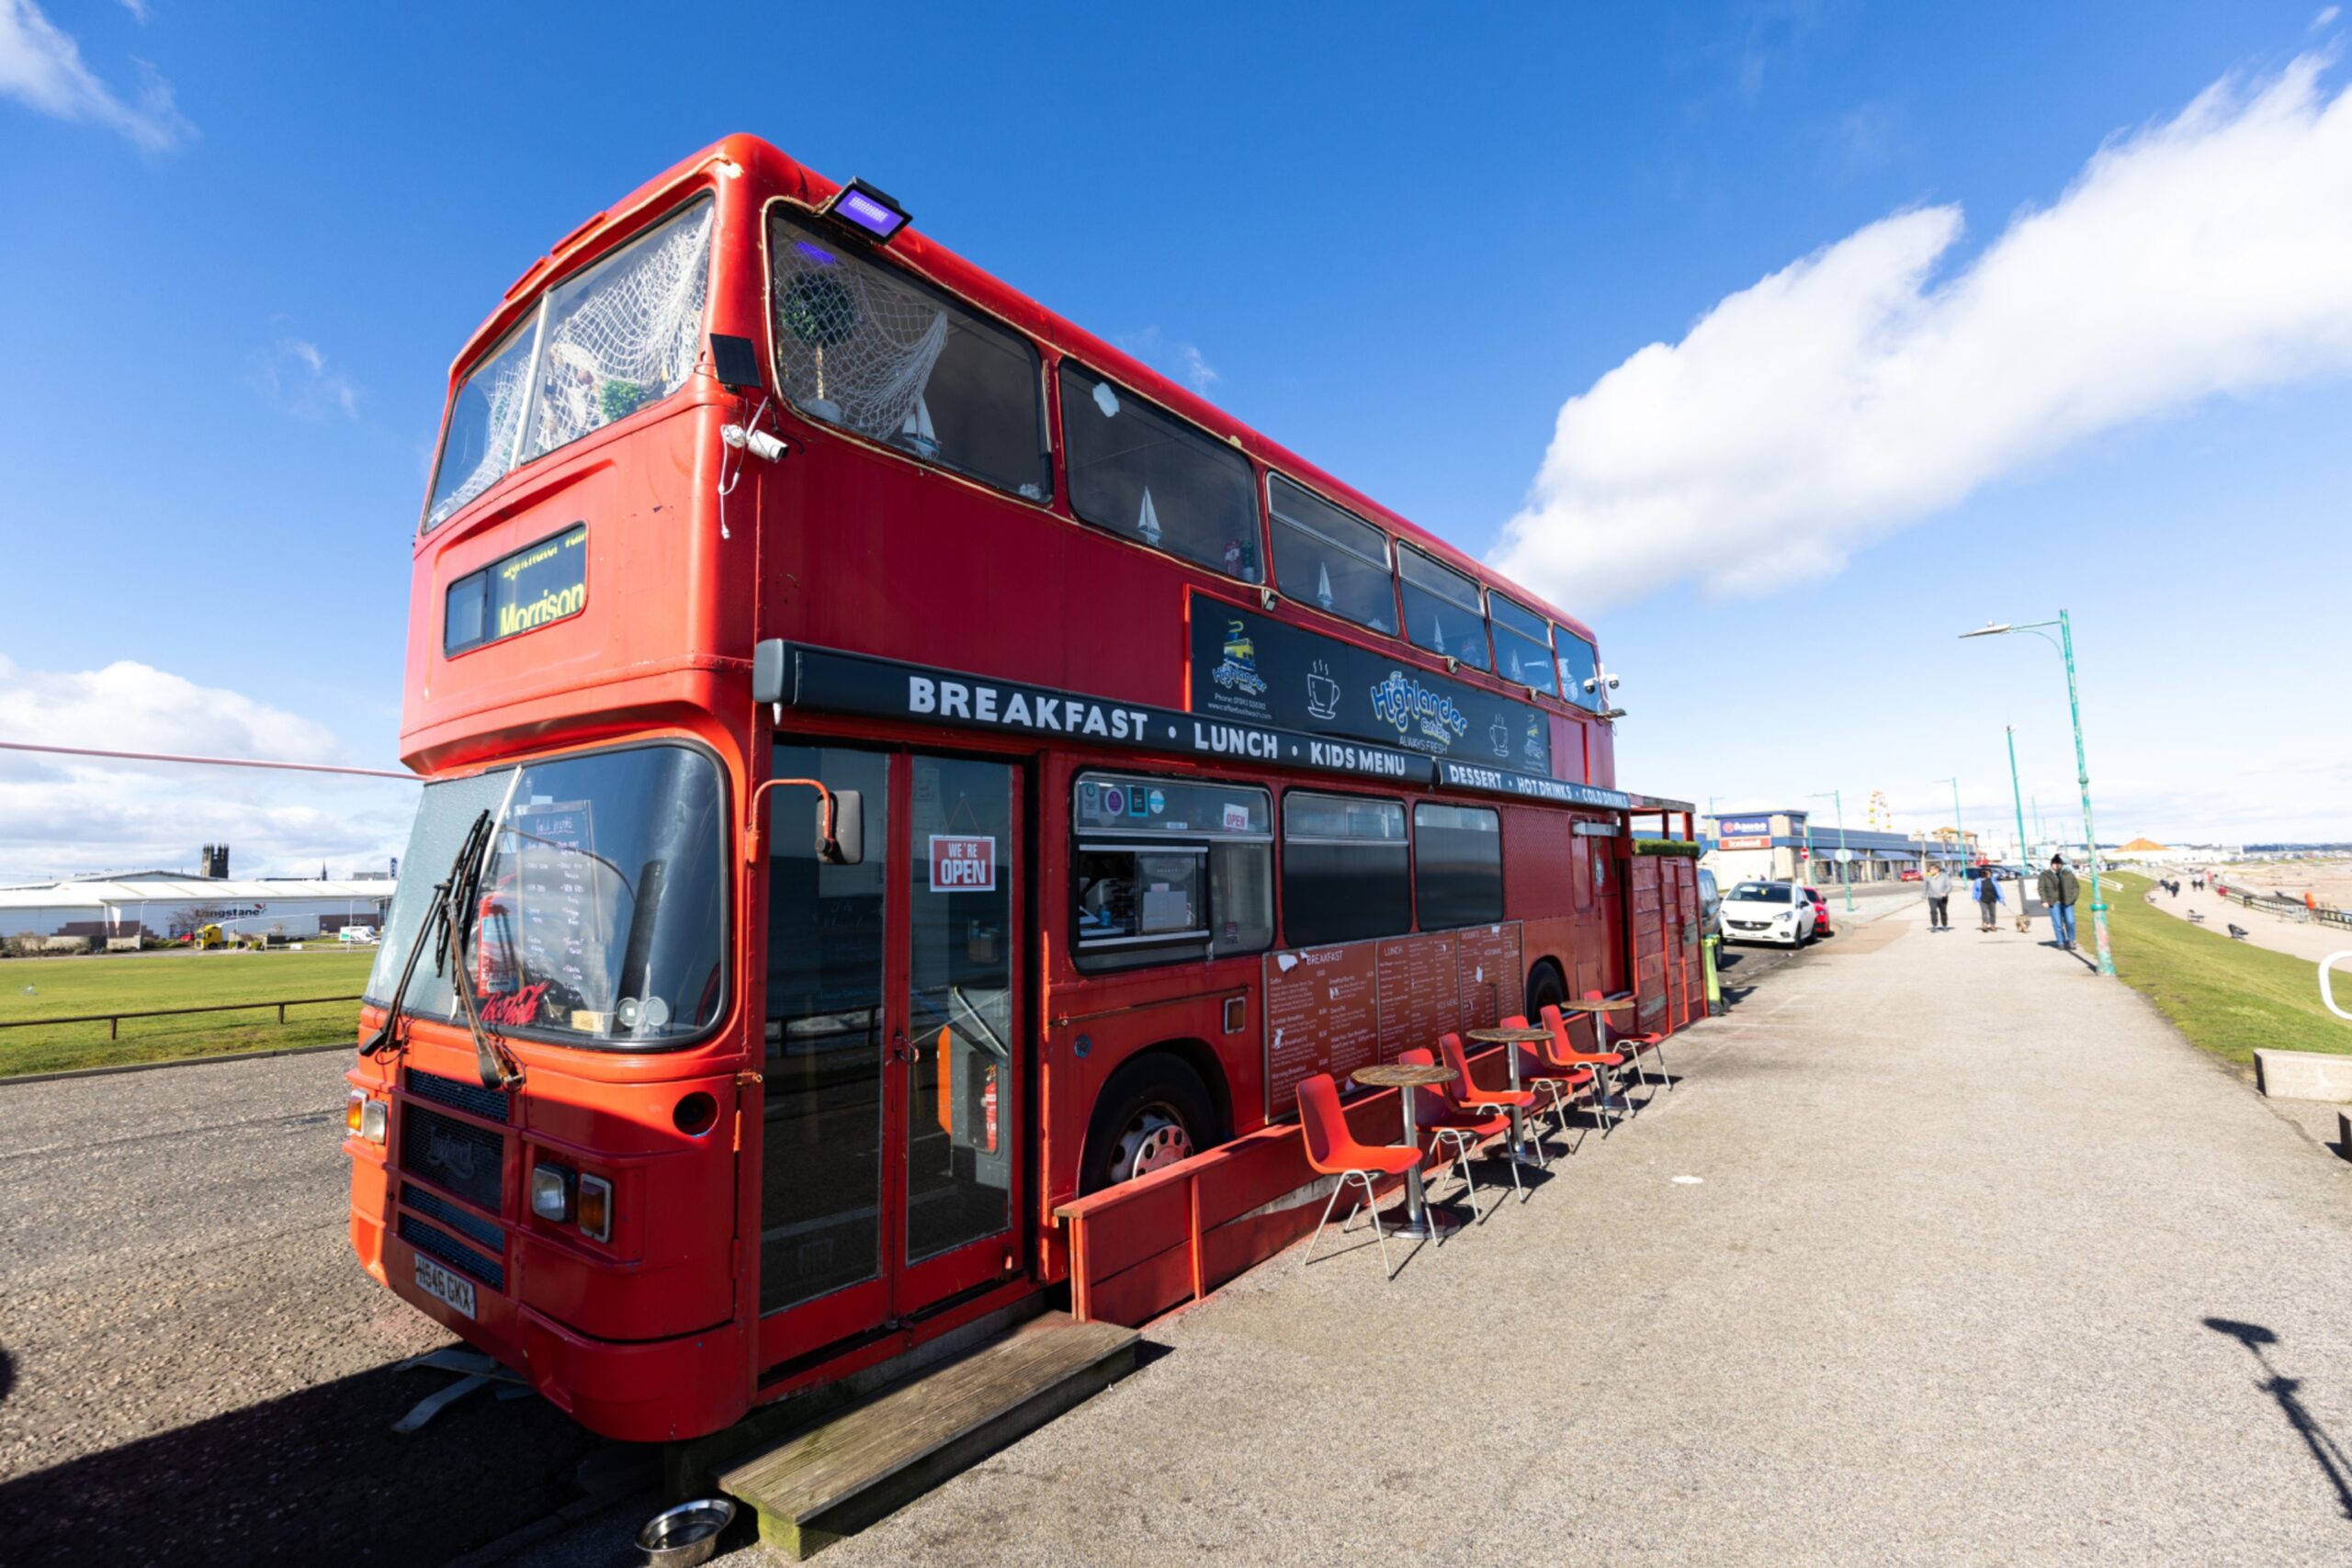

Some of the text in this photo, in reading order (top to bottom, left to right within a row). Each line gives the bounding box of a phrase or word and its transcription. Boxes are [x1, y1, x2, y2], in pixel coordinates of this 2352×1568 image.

[498, 581, 585, 637] Morrison
[1370, 678, 1467, 738] Highlander
[909, 675, 1406, 776] BREAKFAST LUNCH KIDS MENU
[1399, 736, 1448, 755] ALWAYS FRESH
[1448, 764, 1502, 790] DESSERT
[1517, 777, 1539, 795] HOT
[1539, 780, 1573, 800] DRINKS
[1581, 788, 1603, 804] COLD
[1226, 813, 1245, 828] OPEN
[947, 842, 978, 858] WE'RE
[940, 859, 987, 885] OPEN
[1306, 950, 1344, 966] BREAKFAST
[1384, 945, 1404, 956] LUNCH
